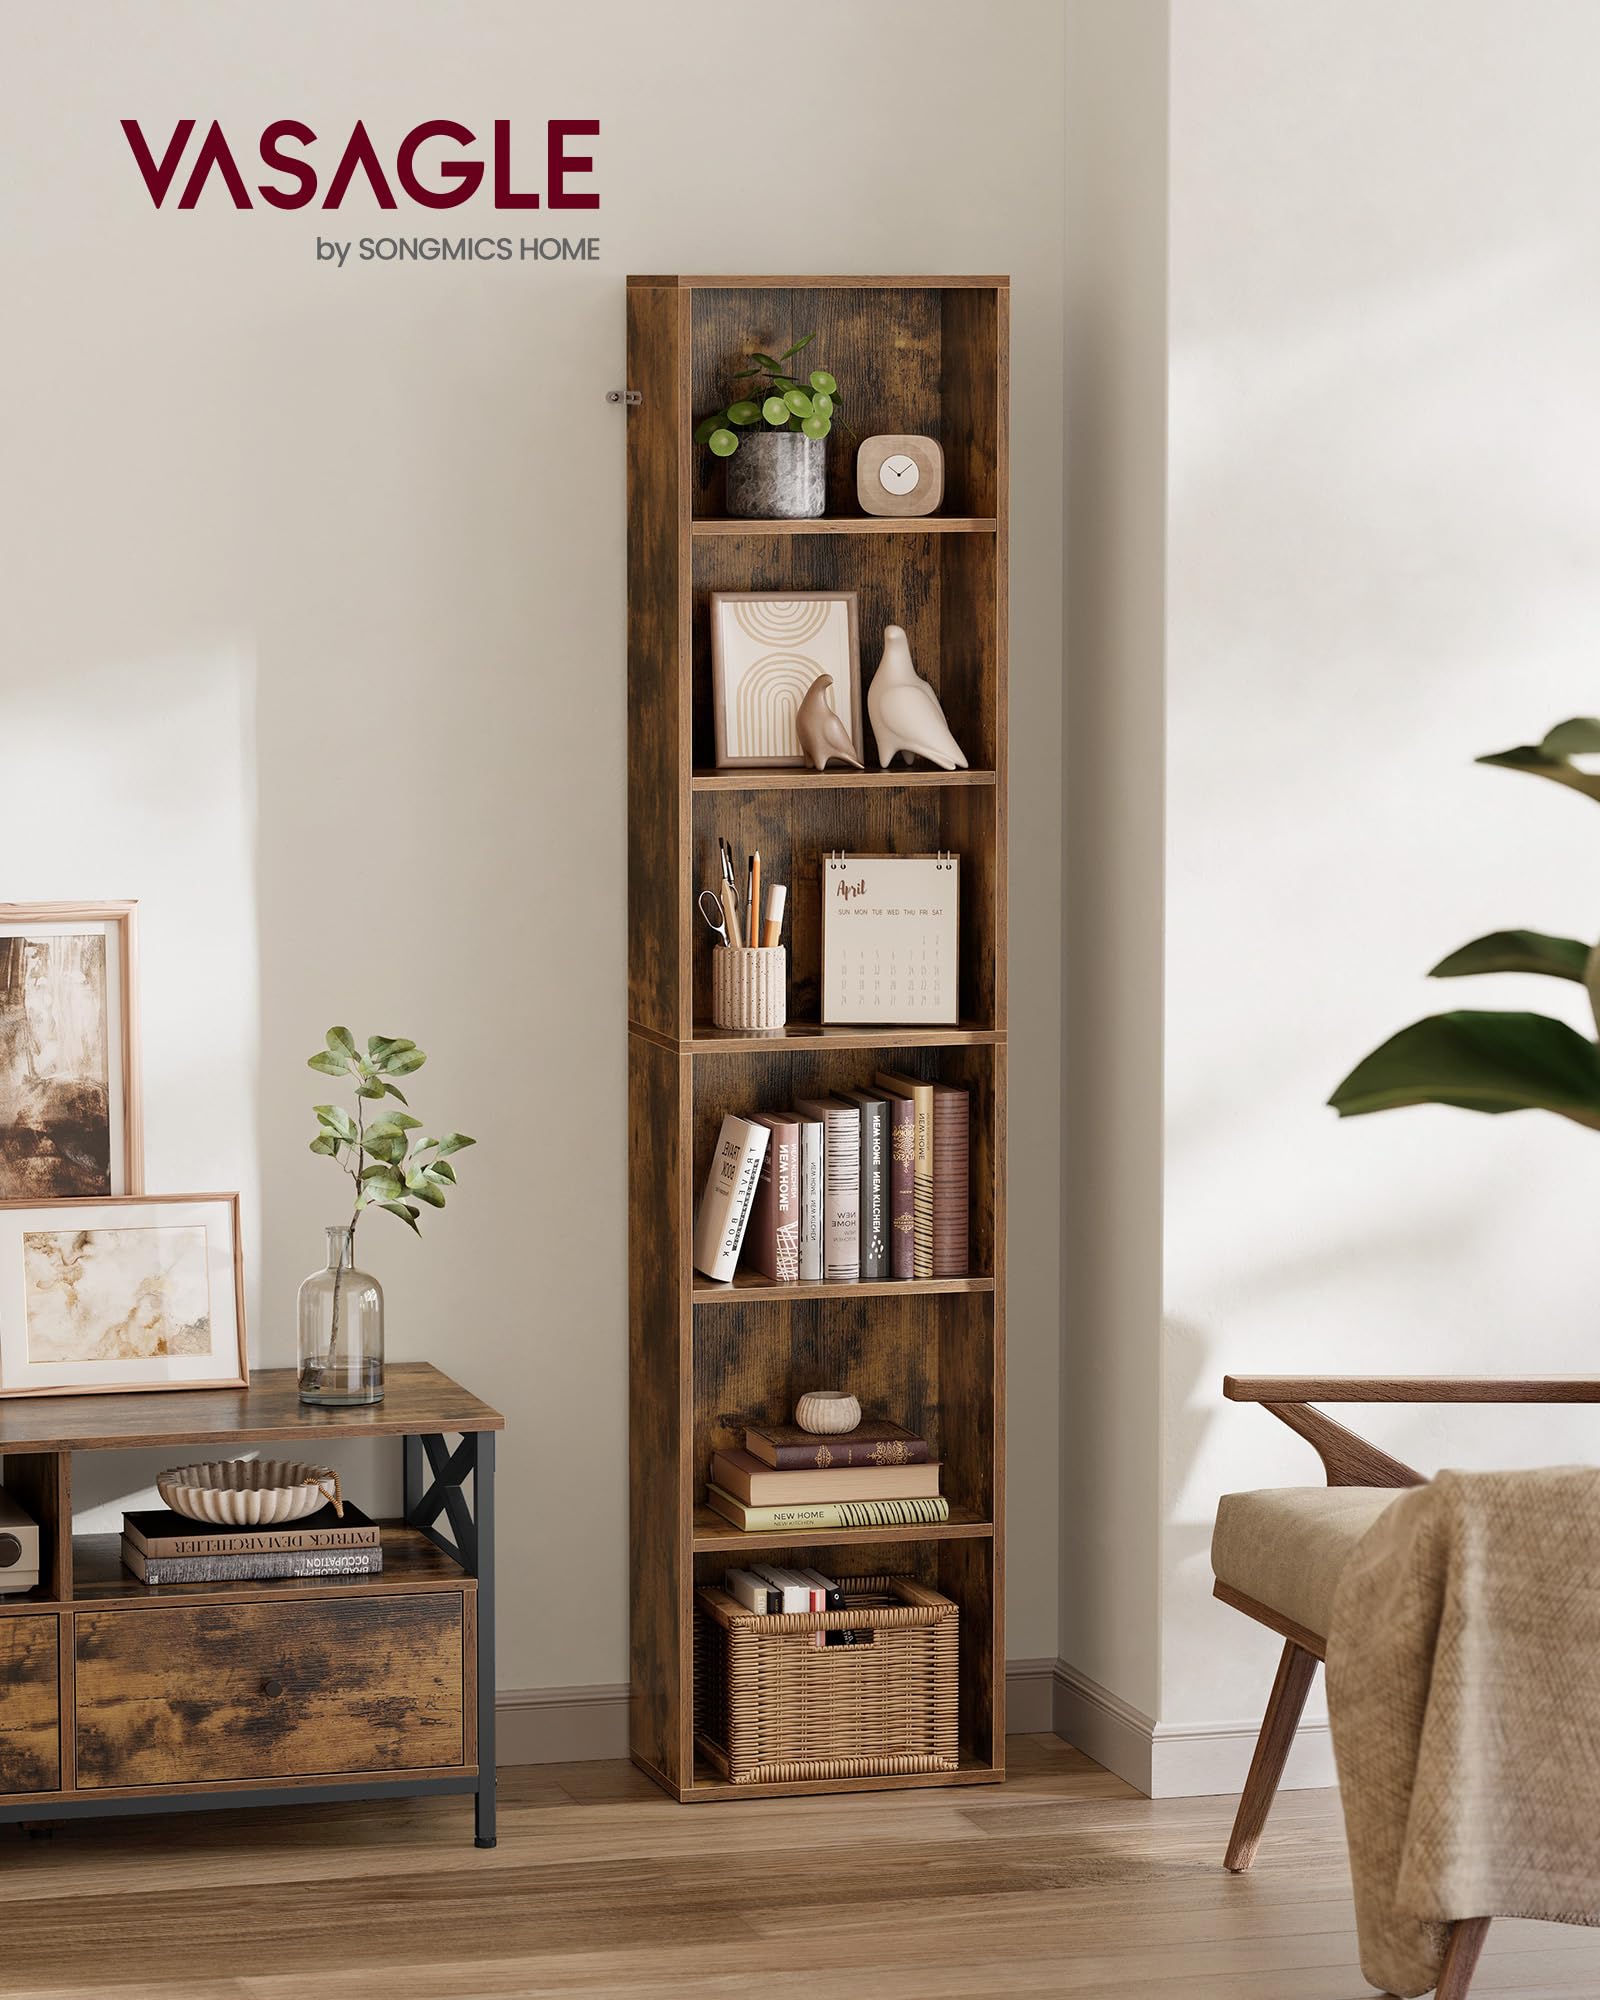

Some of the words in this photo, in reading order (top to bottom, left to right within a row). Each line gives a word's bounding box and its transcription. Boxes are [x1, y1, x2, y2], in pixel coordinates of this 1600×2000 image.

[837, 879, 867, 901] April
[797, 1511, 825, 1519] HOME
[174, 1535, 304, 1553] DEMARCHELIER
[309, 1531, 376, 1549] PATRICK
[306, 1555, 370, 1568] OCCUPATION
[342, 1566, 370, 1575] BRAD
